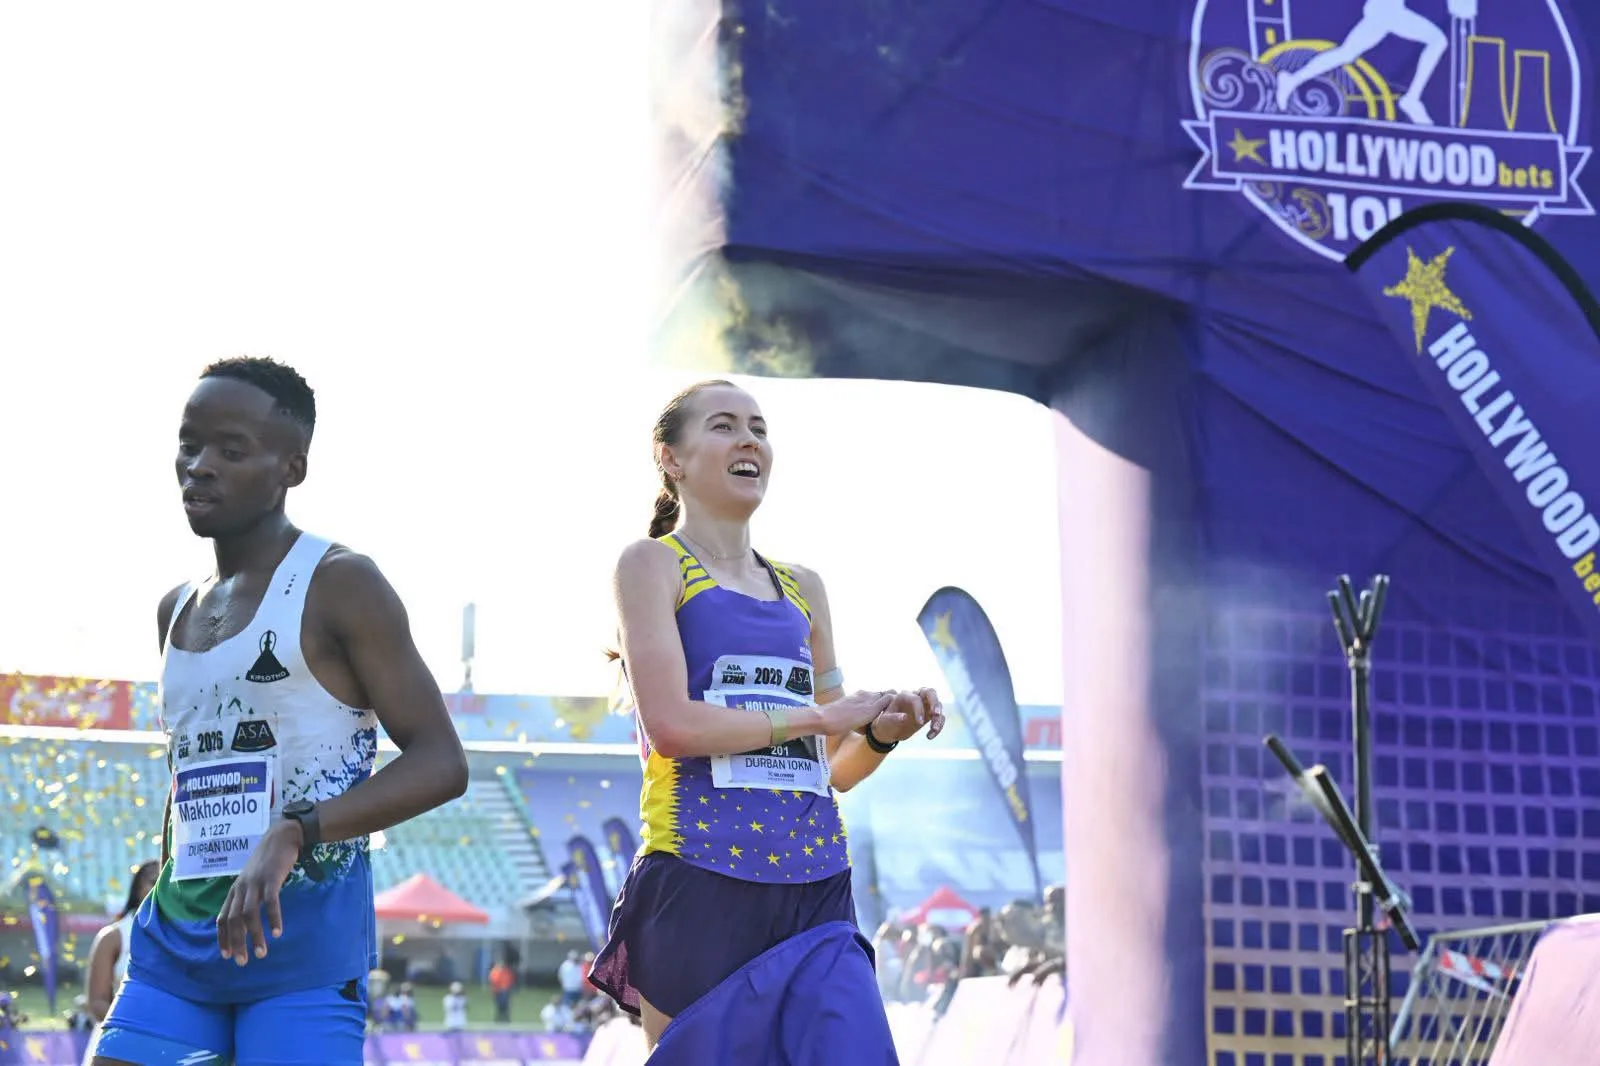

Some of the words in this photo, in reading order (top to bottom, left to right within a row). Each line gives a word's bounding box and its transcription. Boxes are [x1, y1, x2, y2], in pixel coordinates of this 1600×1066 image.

[754, 667, 783, 686] 2026
[790, 669, 810, 684] ASA
[744, 701, 797, 712] HOLLYWO
[236, 724, 270, 740] ASA
[197, 730, 223, 753] 2026
[771, 745, 789, 756] 201
[745, 758, 785, 769] DURBAN
[788, 759, 812, 772] 10KM
[179, 796, 258, 823] Makhokolo
[200, 827, 206, 837] A
[209, 823, 232, 836] 1227
[222, 838, 249, 852] 10KM
